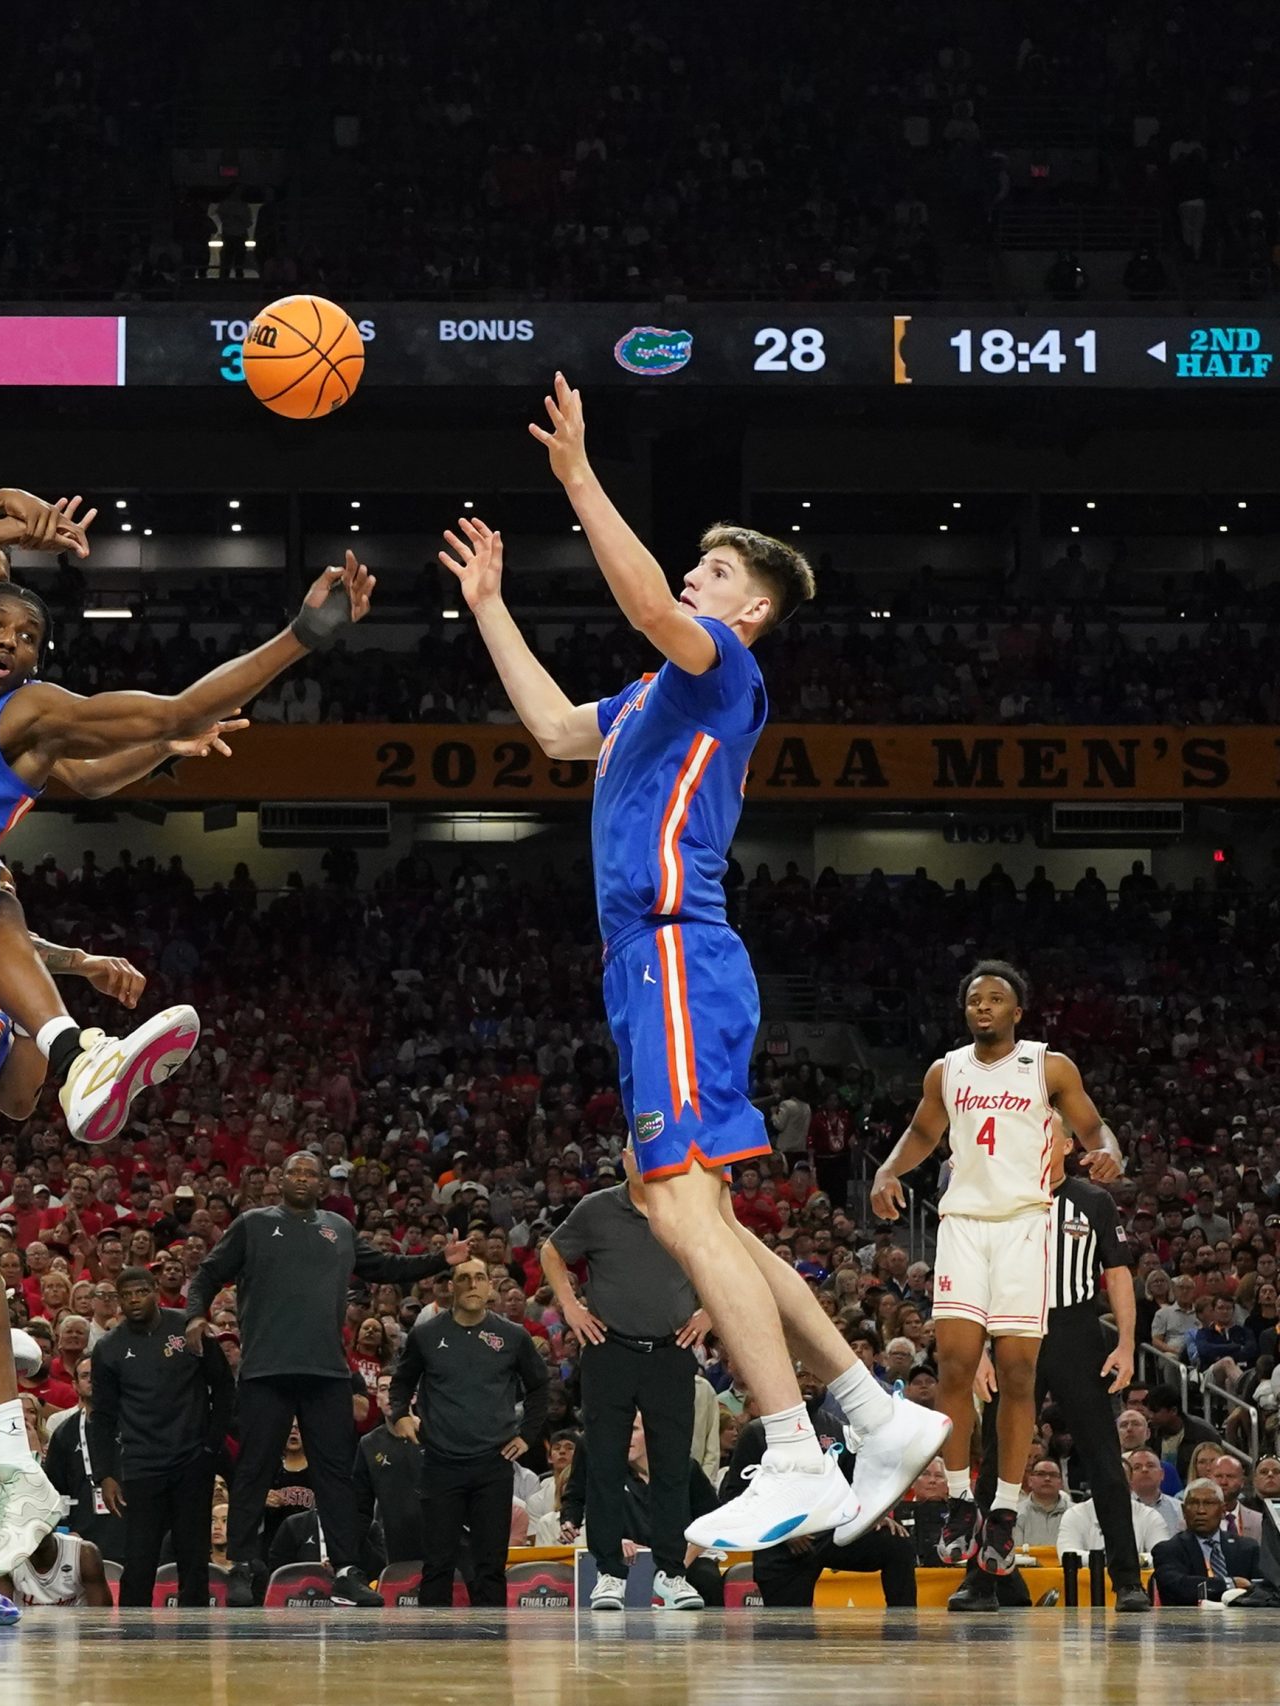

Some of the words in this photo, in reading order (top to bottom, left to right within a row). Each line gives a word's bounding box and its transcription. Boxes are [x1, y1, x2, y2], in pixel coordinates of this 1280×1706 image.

[439, 320, 534, 341] BONUS
[1190, 328, 1261, 352] 2ND
[754, 327, 826, 372] 28
[950, 329, 1096, 373] 18:41
[1176, 353, 1272, 377] HALF
[932, 738, 1230, 788] MEN'S
[954, 1086, 1031, 1113] Houston
[976, 1116, 996, 1156] 4
[398, 1596, 419, 1606] FINA
[520, 1597, 544, 1607] FINAL
[545, 1597, 569, 1607] FOUR
